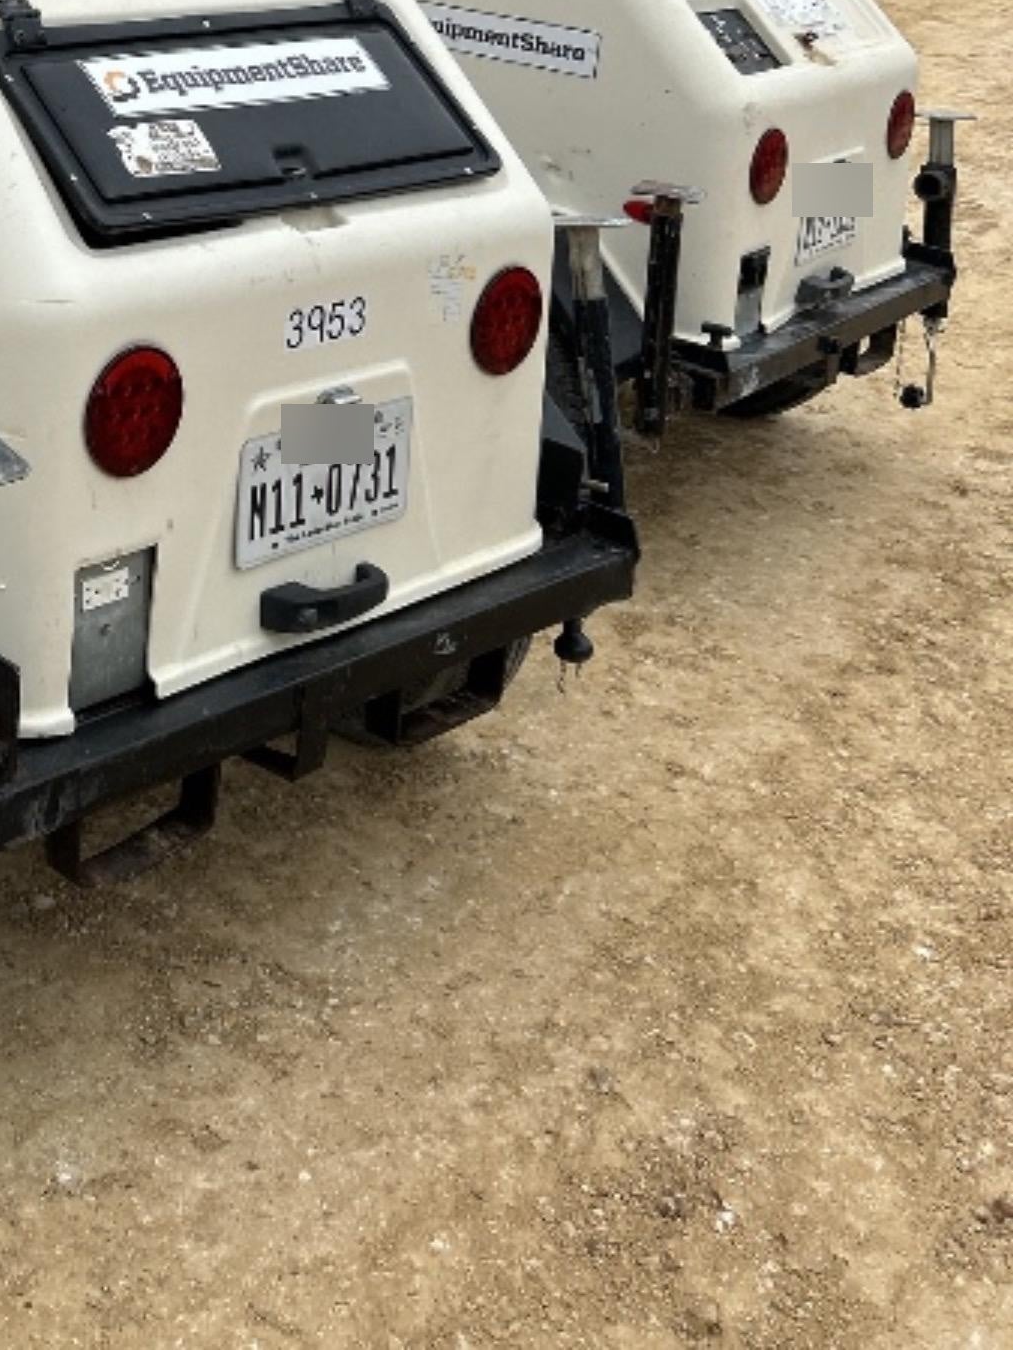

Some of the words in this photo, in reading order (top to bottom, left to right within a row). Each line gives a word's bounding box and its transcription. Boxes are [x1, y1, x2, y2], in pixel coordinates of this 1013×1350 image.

[431, 17, 586, 62] uipmentShare
[139, 52, 367, 96] EquipmentShare
[286, 295, 366, 349] 3953
